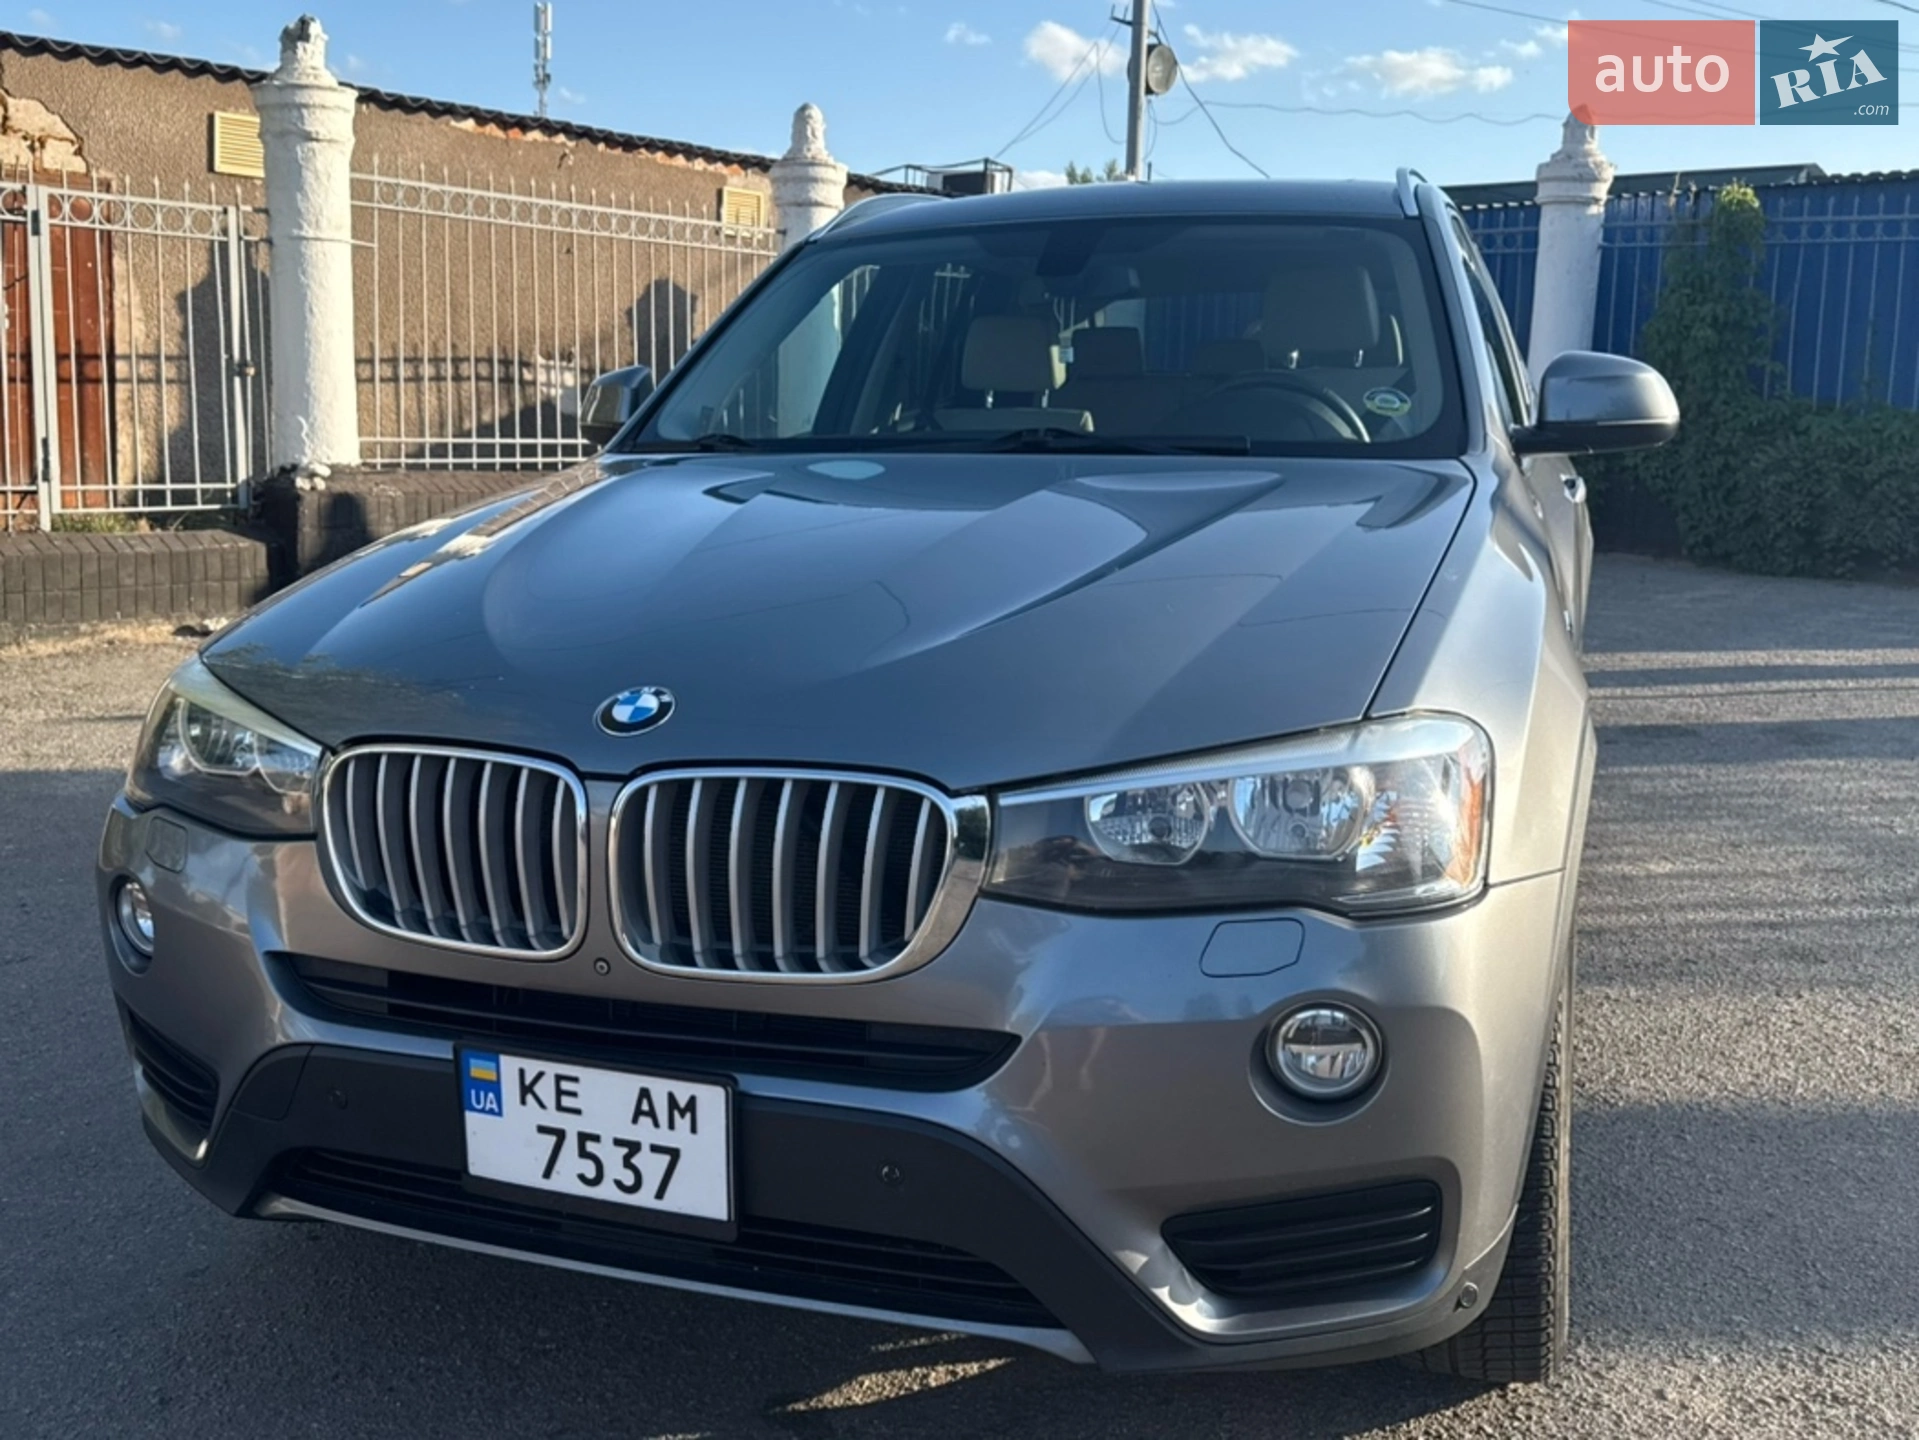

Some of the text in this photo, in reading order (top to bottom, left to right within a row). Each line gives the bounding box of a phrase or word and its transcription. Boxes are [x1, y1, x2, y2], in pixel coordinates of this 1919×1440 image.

[470, 1089, 500, 1113] UA
[518, 1067, 698, 1135] KE AM
[536, 1124, 682, 1201] 7537
